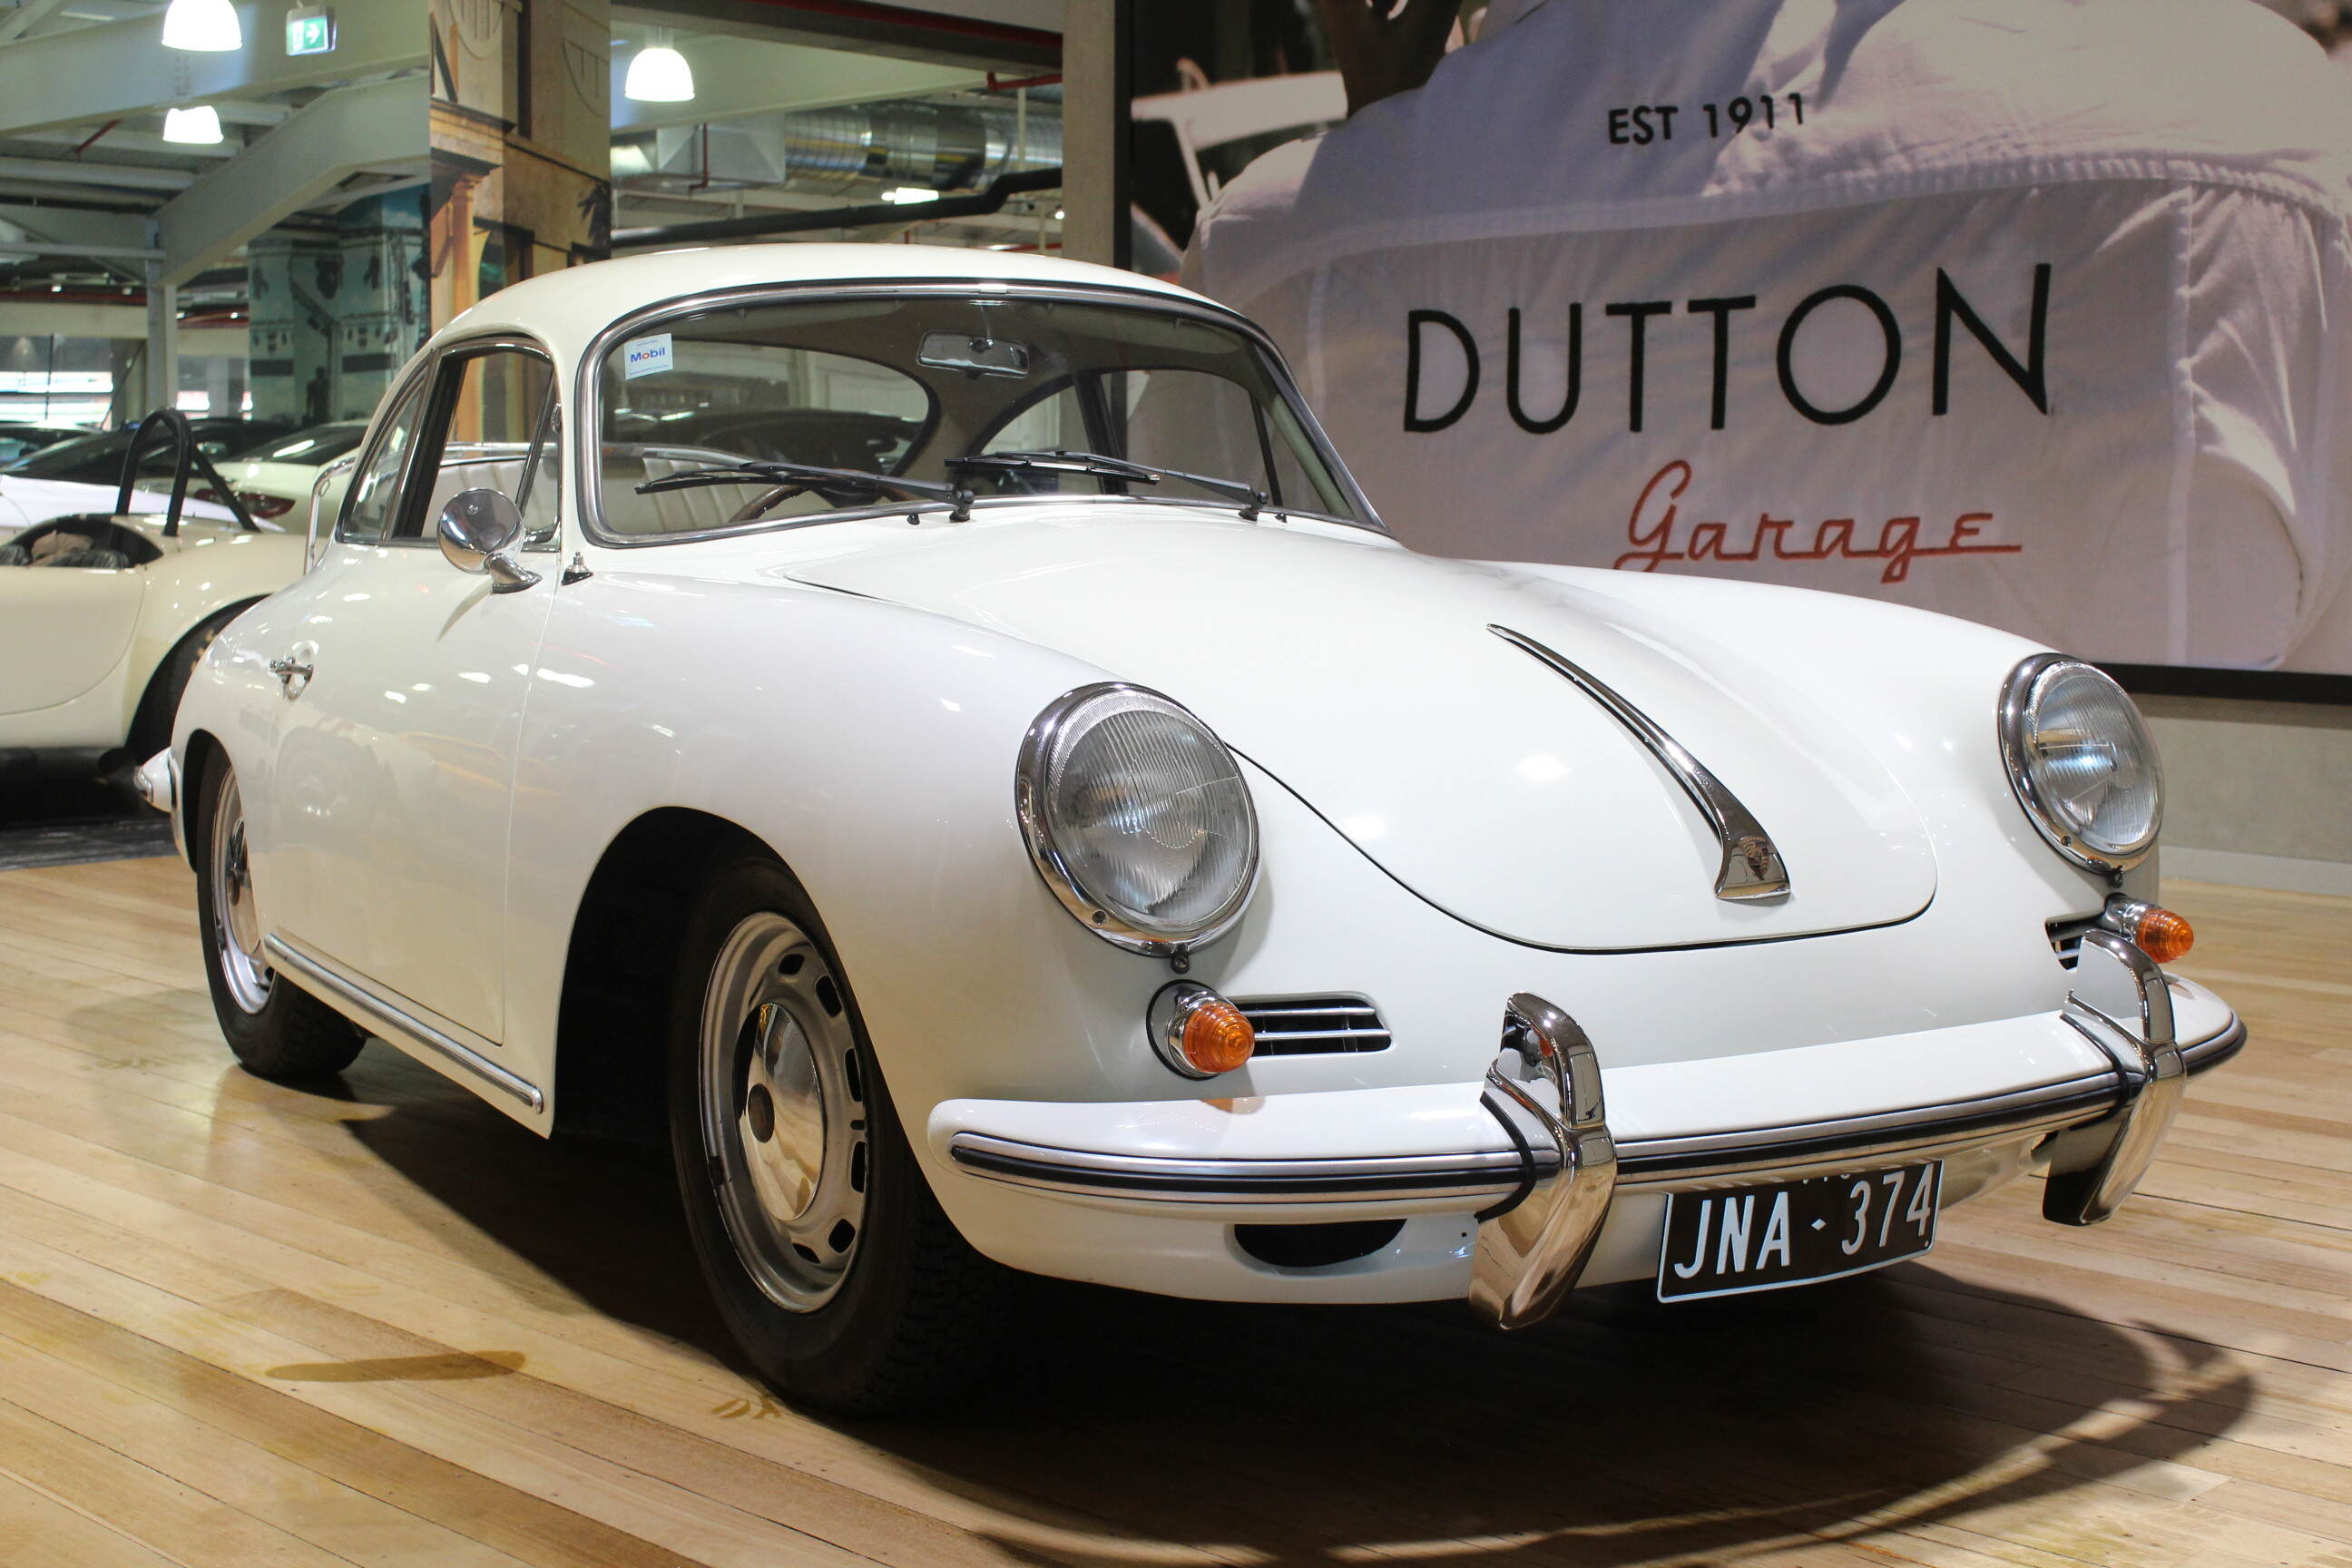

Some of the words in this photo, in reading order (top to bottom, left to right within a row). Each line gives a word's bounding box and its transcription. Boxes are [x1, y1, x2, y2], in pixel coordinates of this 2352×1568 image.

[1608, 104, 1679, 145] EST
[1701, 93, 1804, 138] 1911
[630, 347, 666, 363] Mobil
[1403, 262, 2053, 435] DUTTON
[1612, 459, 2023, 584] Garage
[1673, 1191, 1791, 1279] JNA
[1840, 1162, 1935, 1256] 374
